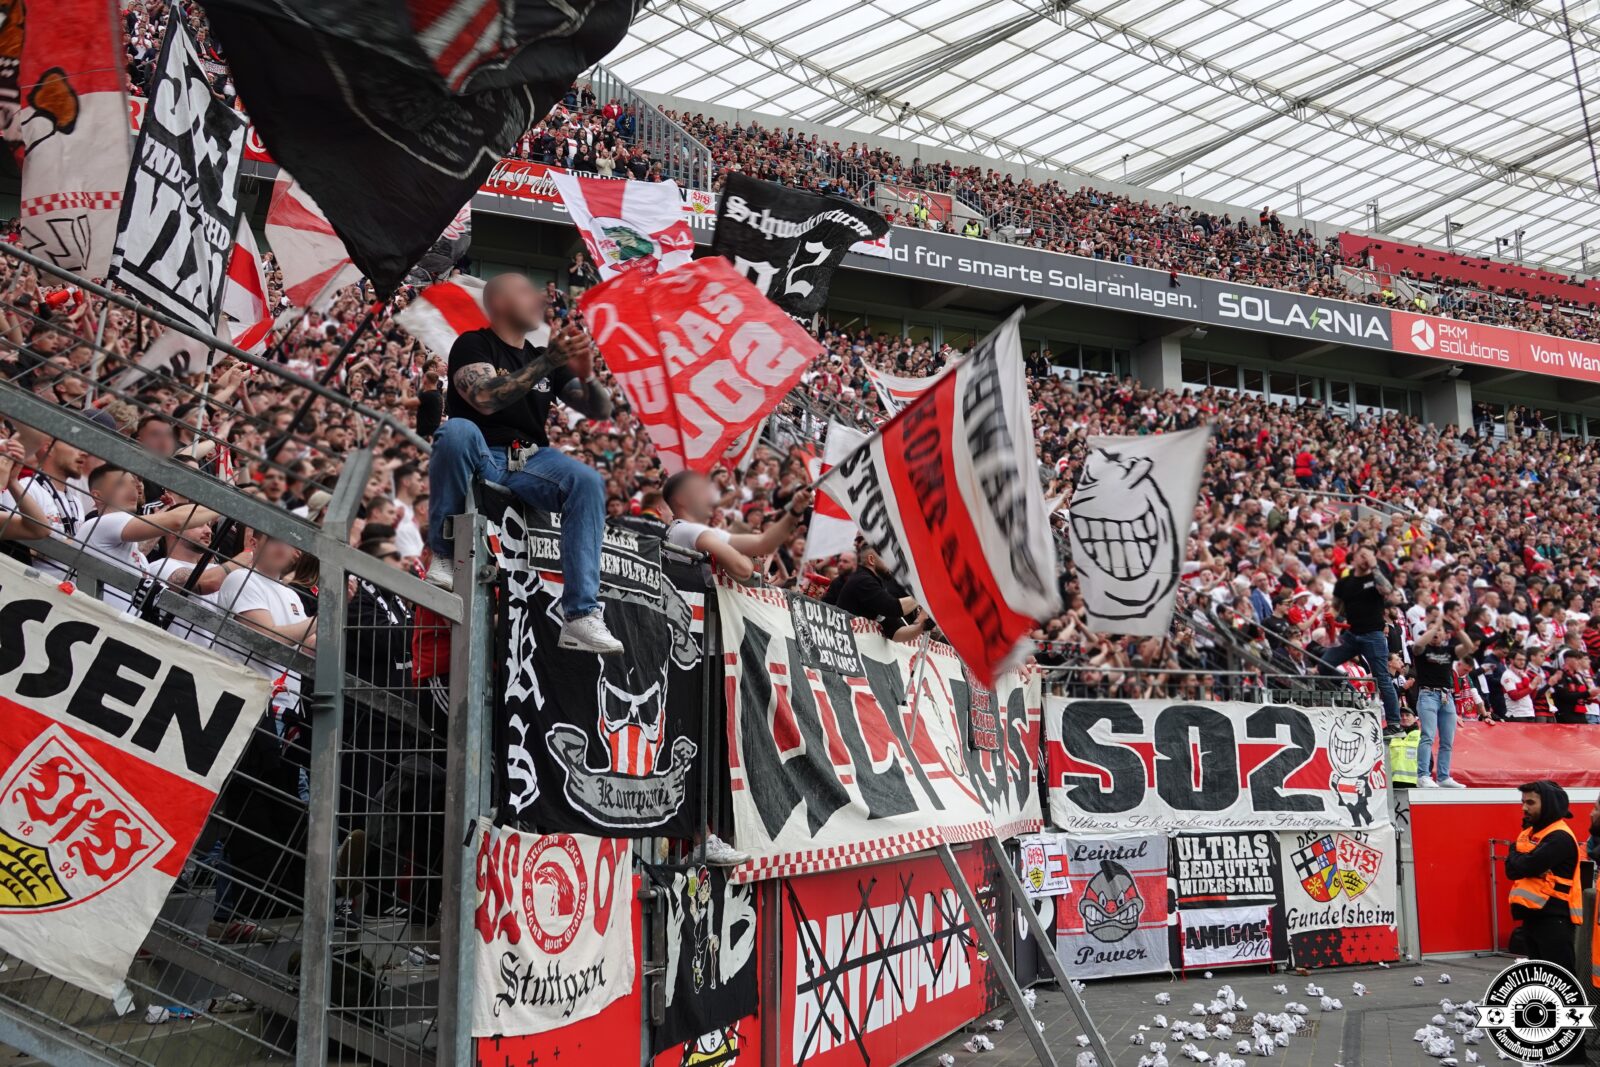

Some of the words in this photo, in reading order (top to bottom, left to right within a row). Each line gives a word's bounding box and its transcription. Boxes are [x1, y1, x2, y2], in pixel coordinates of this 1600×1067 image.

[915, 245, 952, 269] für
[958, 258, 1042, 284] smarte
[1049, 269, 1197, 309] Solaranlagen.
[1218, 291, 1389, 342] SOLARNIA
[1438, 323, 1468, 341] PKM
[1439, 339, 1510, 363] solutions
[1530, 344, 1565, 366] Vom
[1568, 349, 1600, 372] Wan
[621, 559, 661, 591] ULTRAS
[804, 601, 823, 624] DU
[808, 622, 854, 656] IMMER
[596, 777, 672, 815] Kompanie
[17, 819, 34, 837] 18
[1068, 815, 1118, 829] Ultras
[1125, 814, 1265, 829] Schwabensturm
[1269, 813, 1342, 828] Stuttgart
[1070, 840, 1147, 861] Leintal
[1176, 834, 1269, 860] ULTRAS
[58, 861, 78, 879] 93
[1179, 858, 1271, 880] BEDEUTET
[1179, 876, 1274, 896] WIDERSTAND
[1286, 902, 1395, 931] Gundelsheim
[1074, 946, 1147, 965] Power
[1232, 940, 1270, 959] 2010
